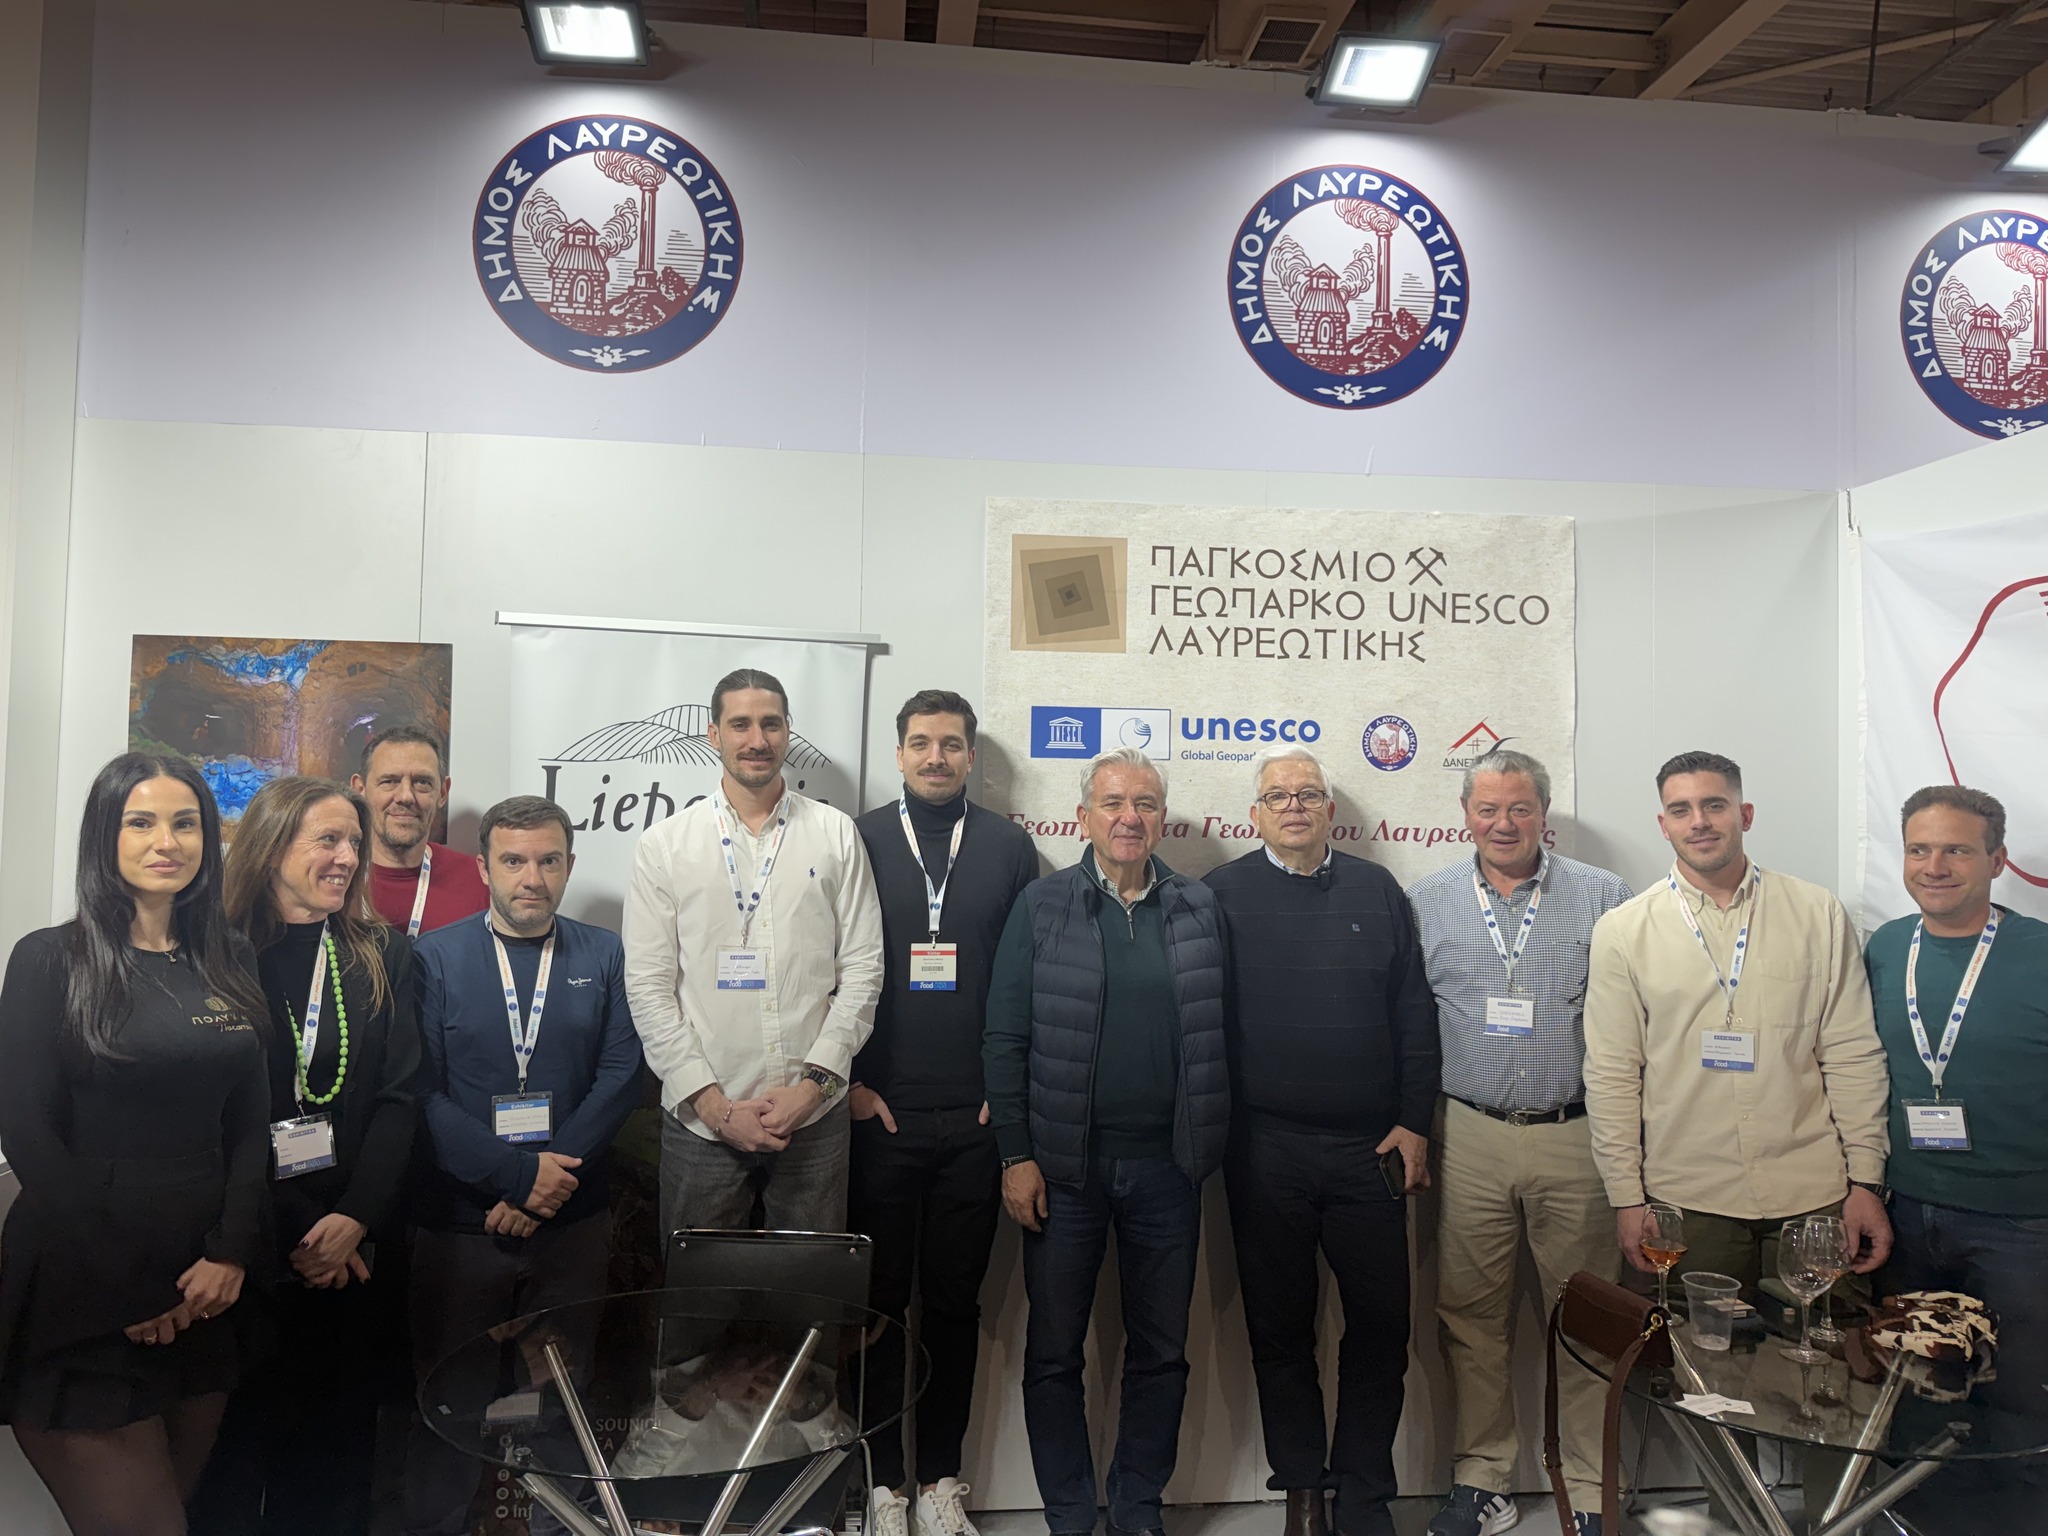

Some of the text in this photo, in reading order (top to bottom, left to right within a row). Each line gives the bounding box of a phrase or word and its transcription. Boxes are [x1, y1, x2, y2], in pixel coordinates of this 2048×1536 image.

[481, 158, 533, 303] ΔΗΜΟΣ
[1235, 206, 1280, 345] ΔΗΜΟΣ
[1907, 248, 1947, 378] ΔΗΜΟΣ
[1151, 545, 1396, 583] ΠΑΓΚΟΣΜΙΟ
[1150, 584, 1550, 626] ΓΕΩΠΑΡΚΟ UNESCO
[1148, 624, 1426, 664] ΛΑΥΡΕΩΤΙΚΗΣ
[1181, 717, 1321, 743] unesco
[1180, 750, 1256, 763] Global Geopar
